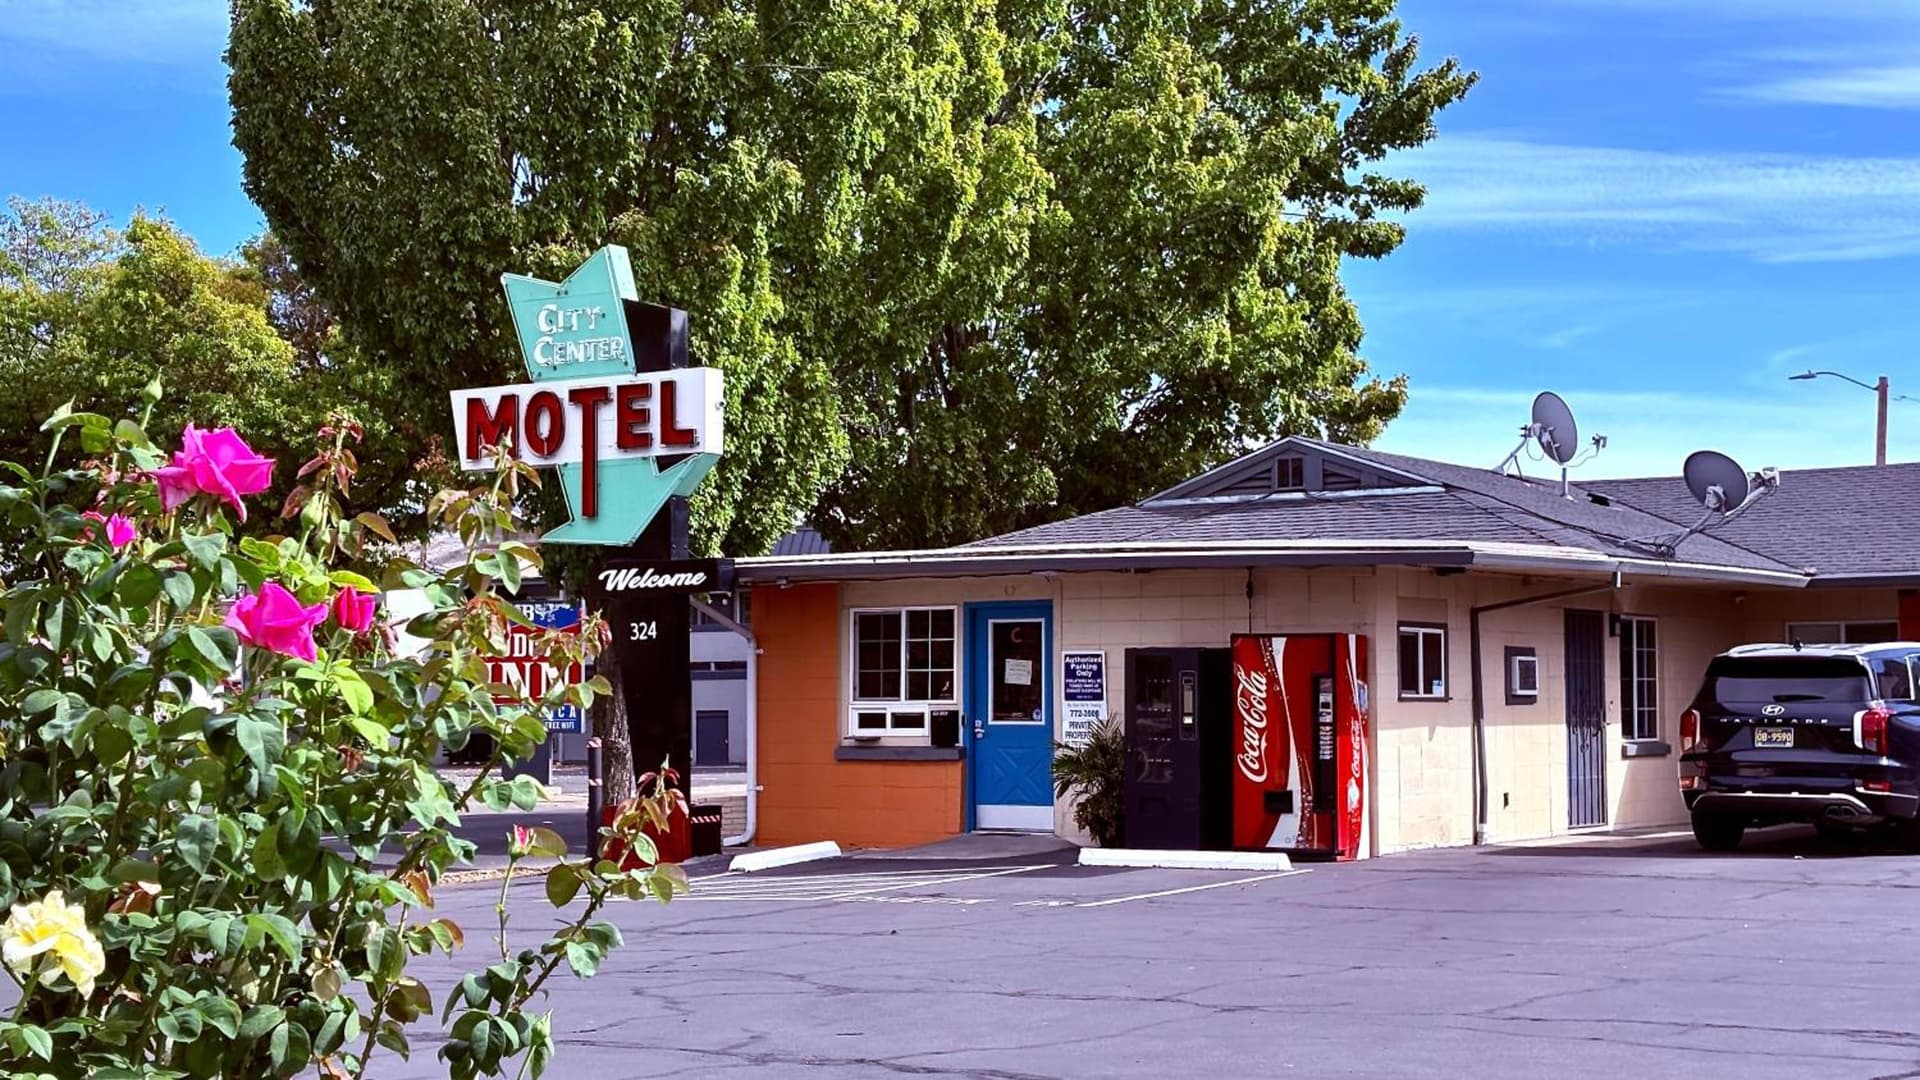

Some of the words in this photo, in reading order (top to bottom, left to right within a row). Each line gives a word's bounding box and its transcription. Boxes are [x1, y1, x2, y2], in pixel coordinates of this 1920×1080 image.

[537, 304, 601, 335] CITY
[533, 336, 626, 368] CENTER
[465, 380, 700, 519] MOTEL
[598, 568, 707, 591] Welcome
[630, 621, 657, 640] 324
[1070, 663, 1098, 671] Parking
[1065, 731, 1090, 739] PROPER
[1237, 664, 1268, 782] Coca-Cola
